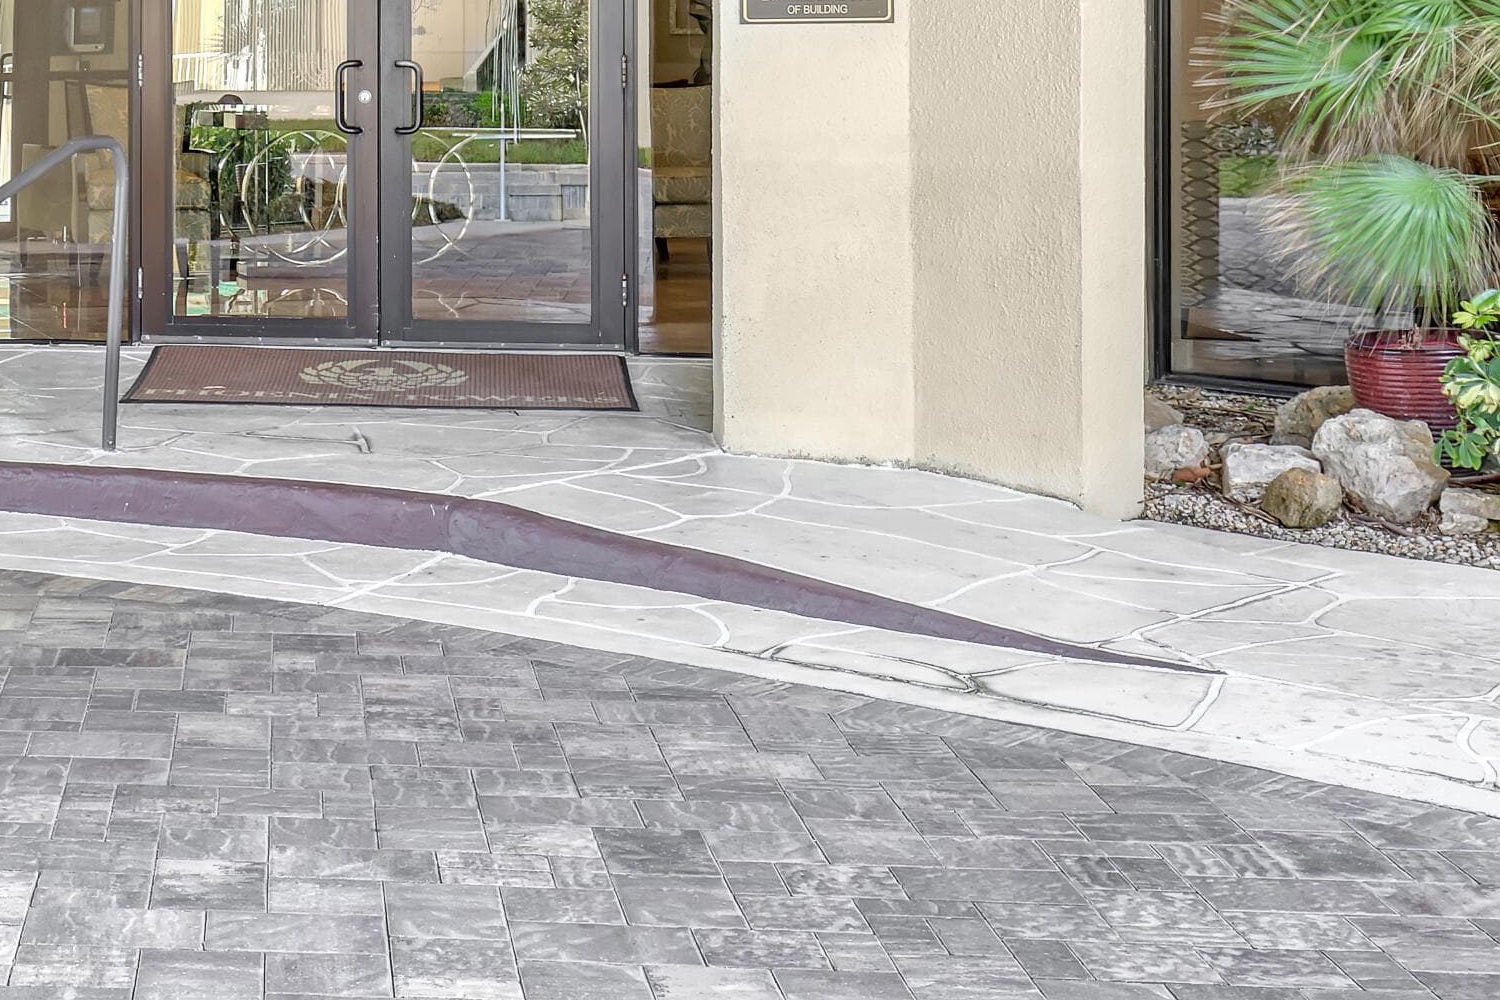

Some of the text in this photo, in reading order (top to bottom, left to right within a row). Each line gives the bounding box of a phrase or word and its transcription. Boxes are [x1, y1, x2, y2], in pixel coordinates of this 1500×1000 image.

[786, 3, 848, 15] OF BUILDING
[144, 388, 375, 400] PHOENIX
